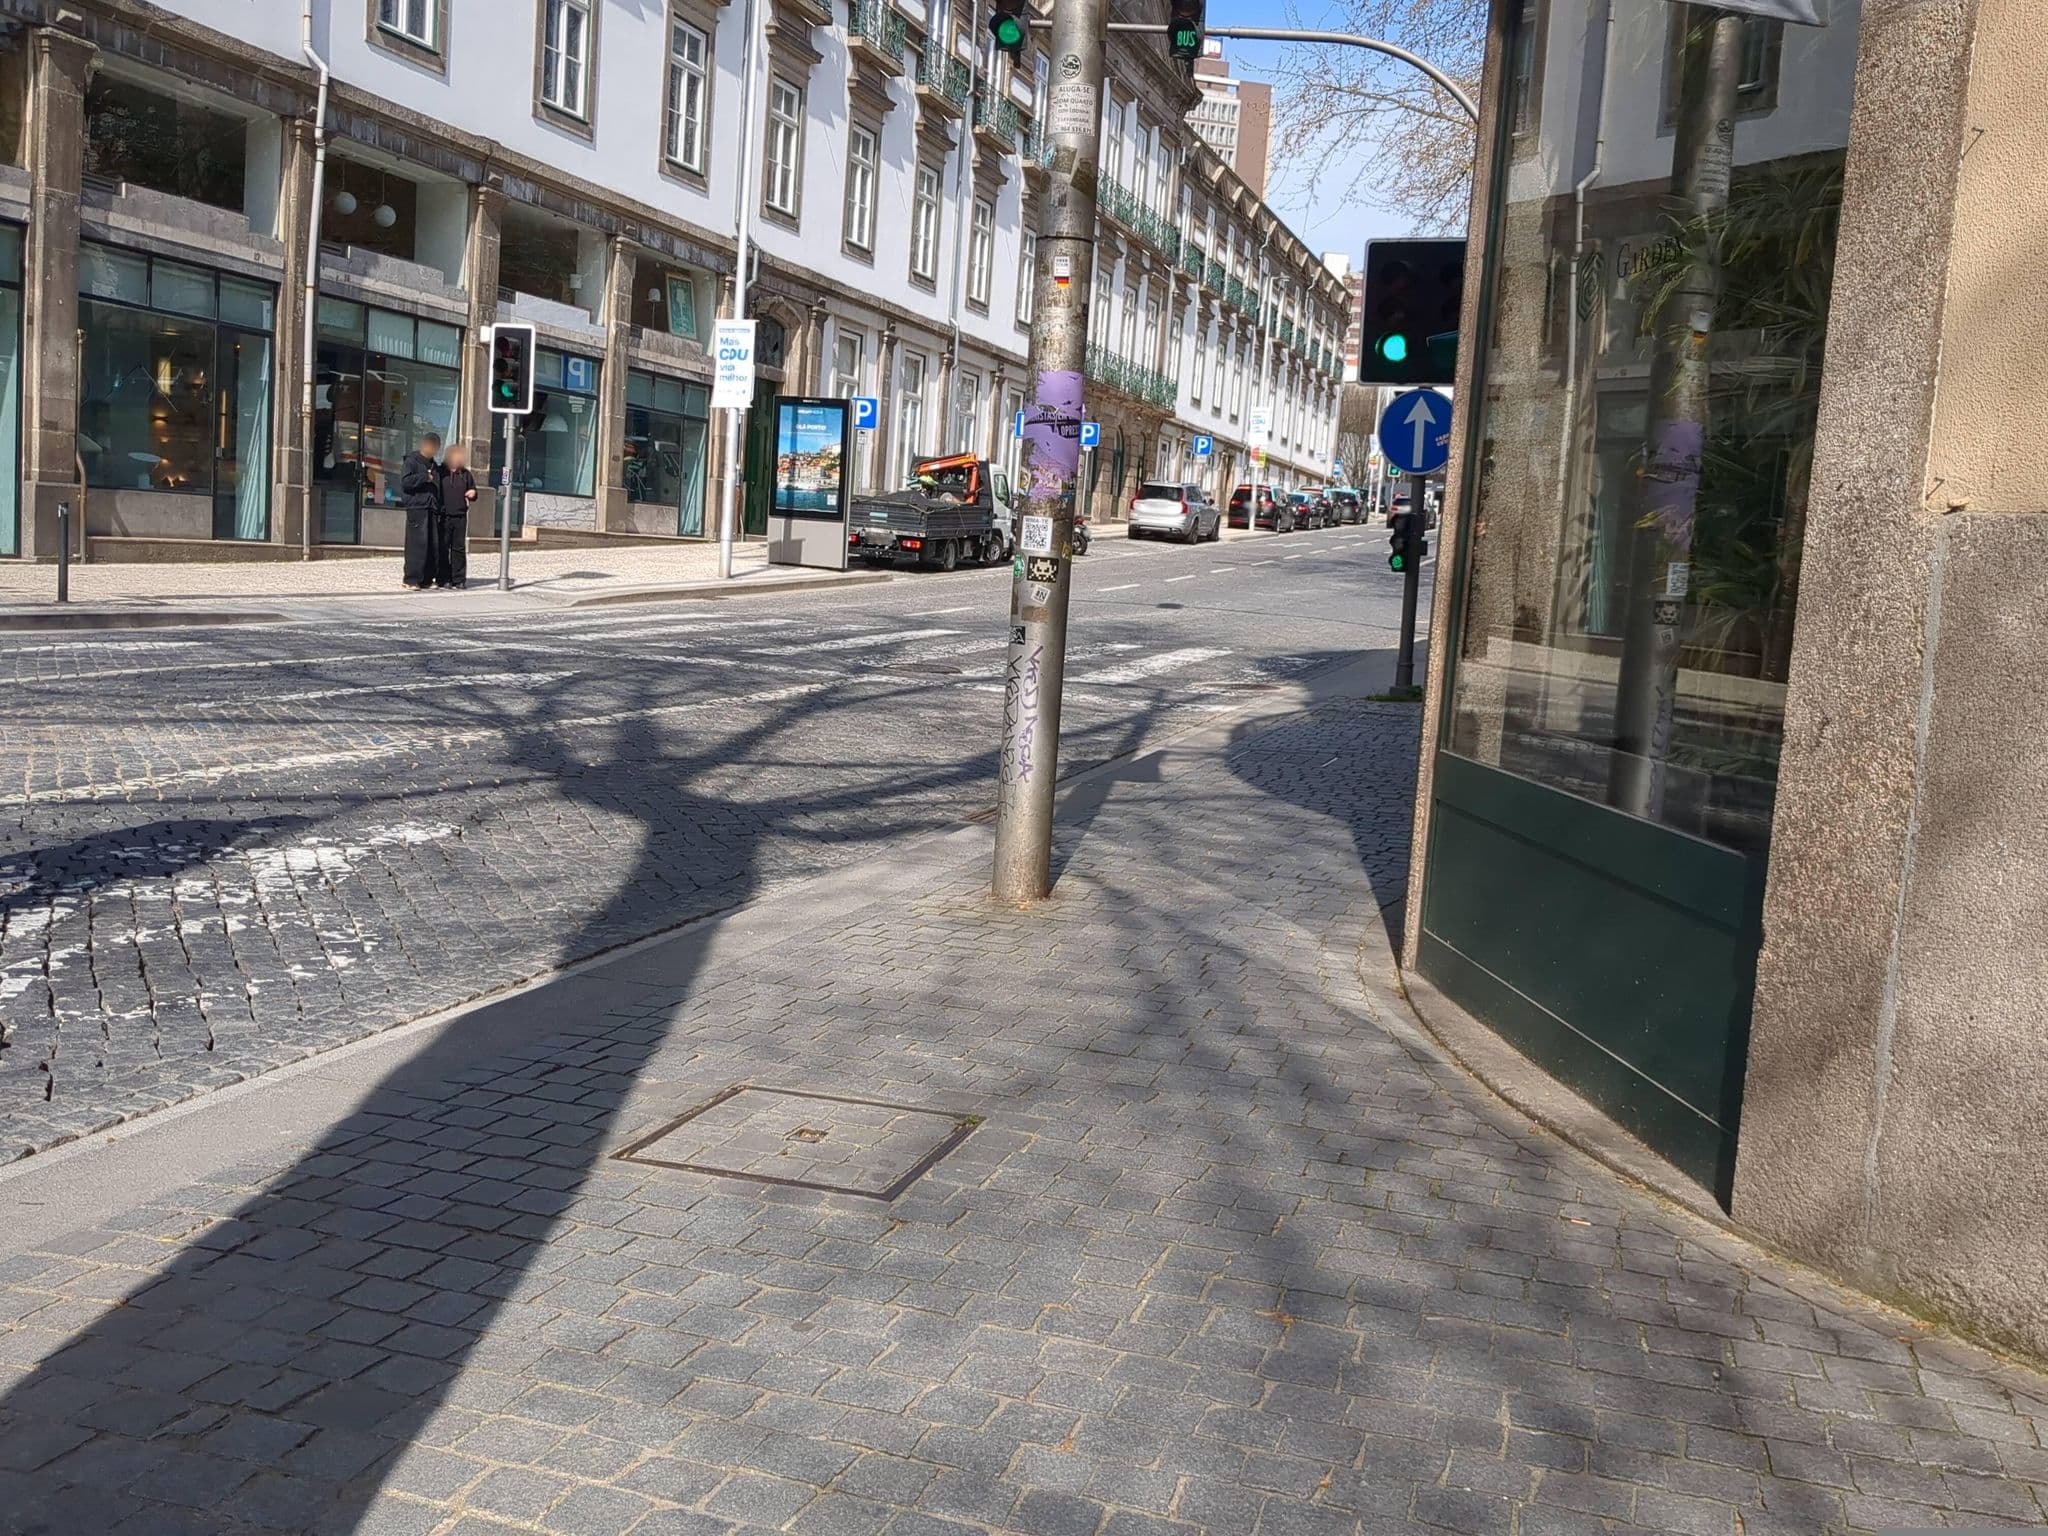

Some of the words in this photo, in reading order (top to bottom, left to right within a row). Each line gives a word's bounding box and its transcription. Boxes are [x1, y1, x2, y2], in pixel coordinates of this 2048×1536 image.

[1177, 31, 1196, 47] BUS
[1059, 85, 1090, 94] ALUGA-SE
[719, 348, 749, 361] CDU
[855, 400, 873, 426] P
[1081, 424, 1095, 444] P
[1197, 437, 1209, 454] P
